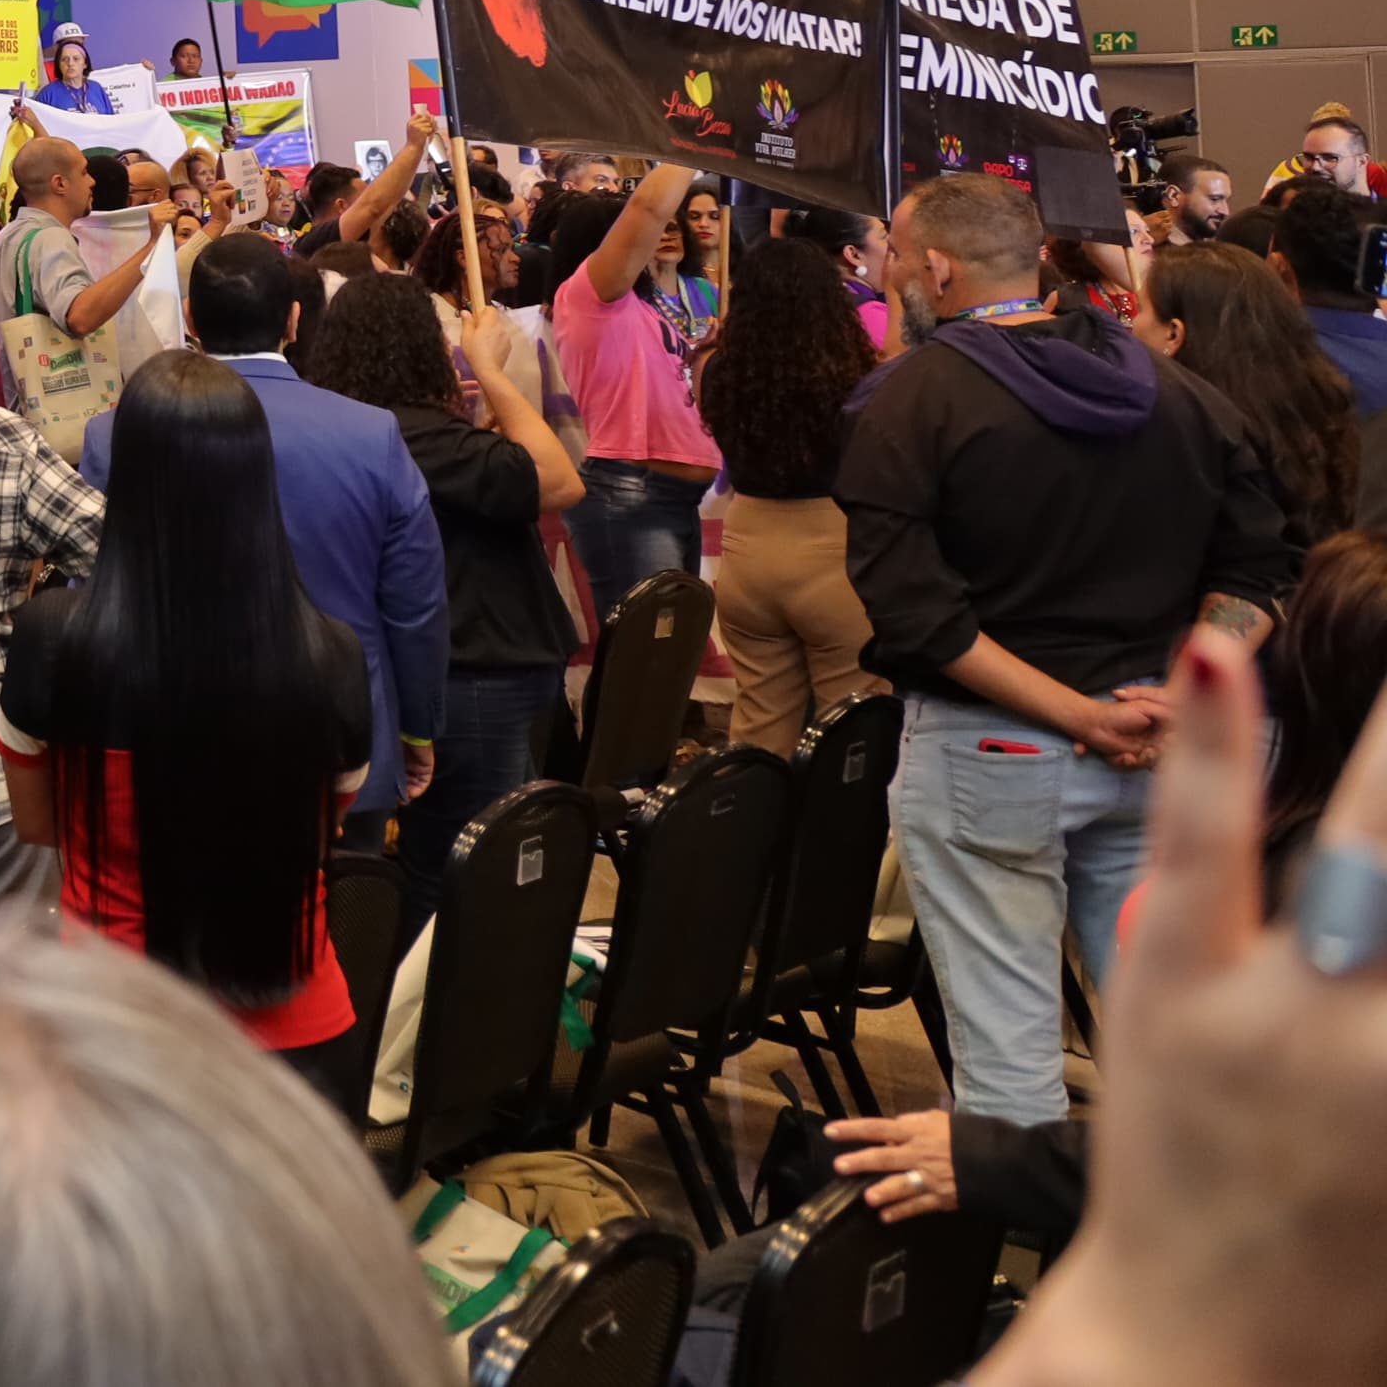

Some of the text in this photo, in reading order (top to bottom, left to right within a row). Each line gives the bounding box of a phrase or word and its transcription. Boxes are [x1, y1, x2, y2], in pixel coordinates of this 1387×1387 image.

[764, 5, 863, 58] MATAR!
[160, 92, 177, 107] VO
[899, 32, 1106, 125] EMINICÍDIO
